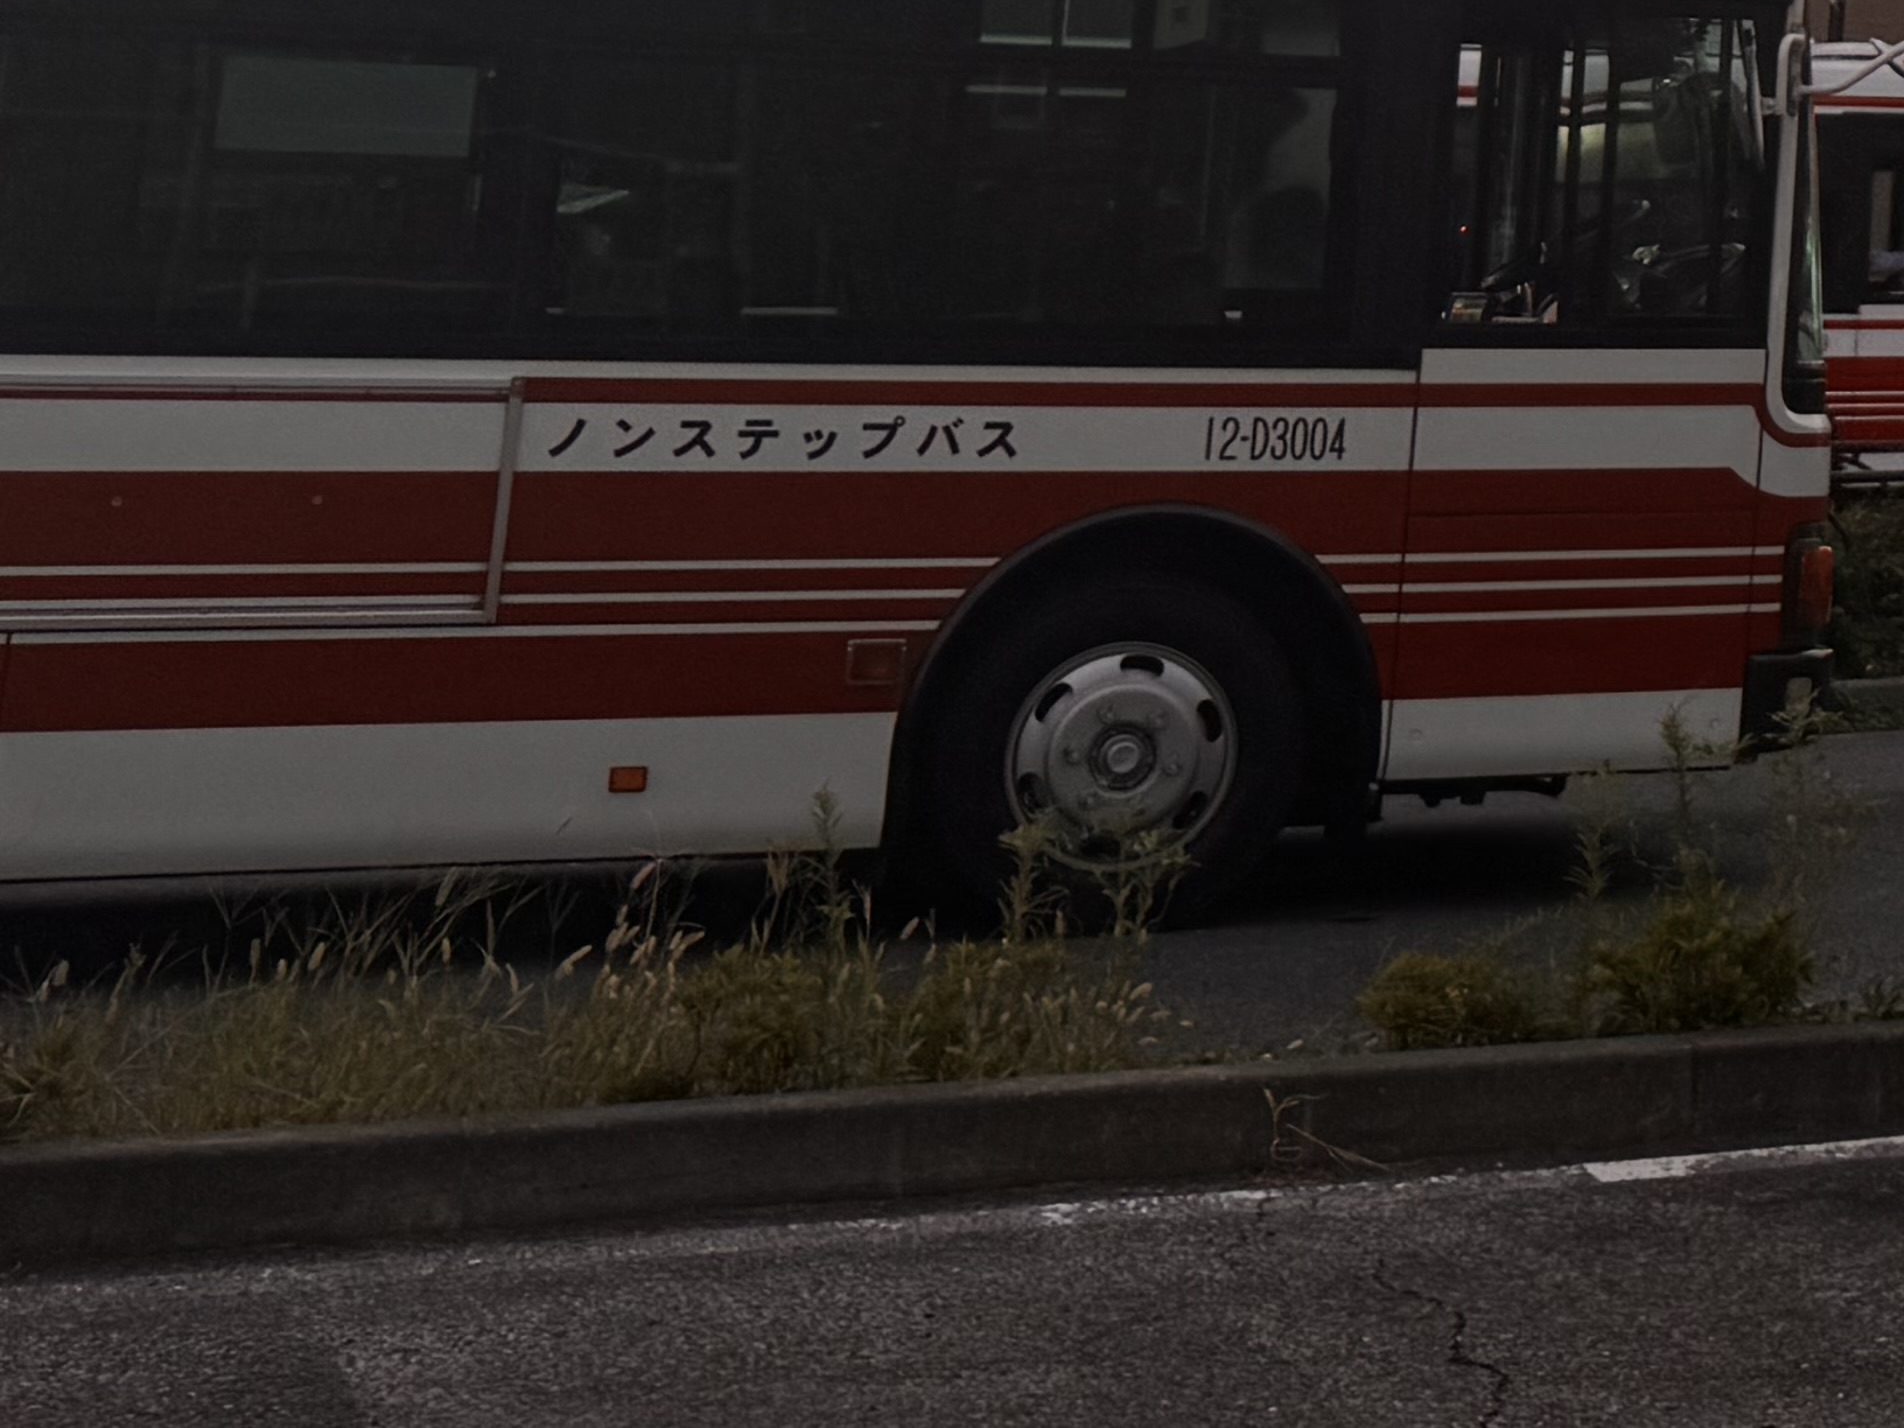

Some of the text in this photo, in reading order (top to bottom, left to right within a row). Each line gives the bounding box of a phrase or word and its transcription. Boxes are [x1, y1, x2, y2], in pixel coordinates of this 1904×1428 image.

[548, 415, 1018, 460] ノンステップバス
[1205, 416, 1346, 461] 12-D3004
